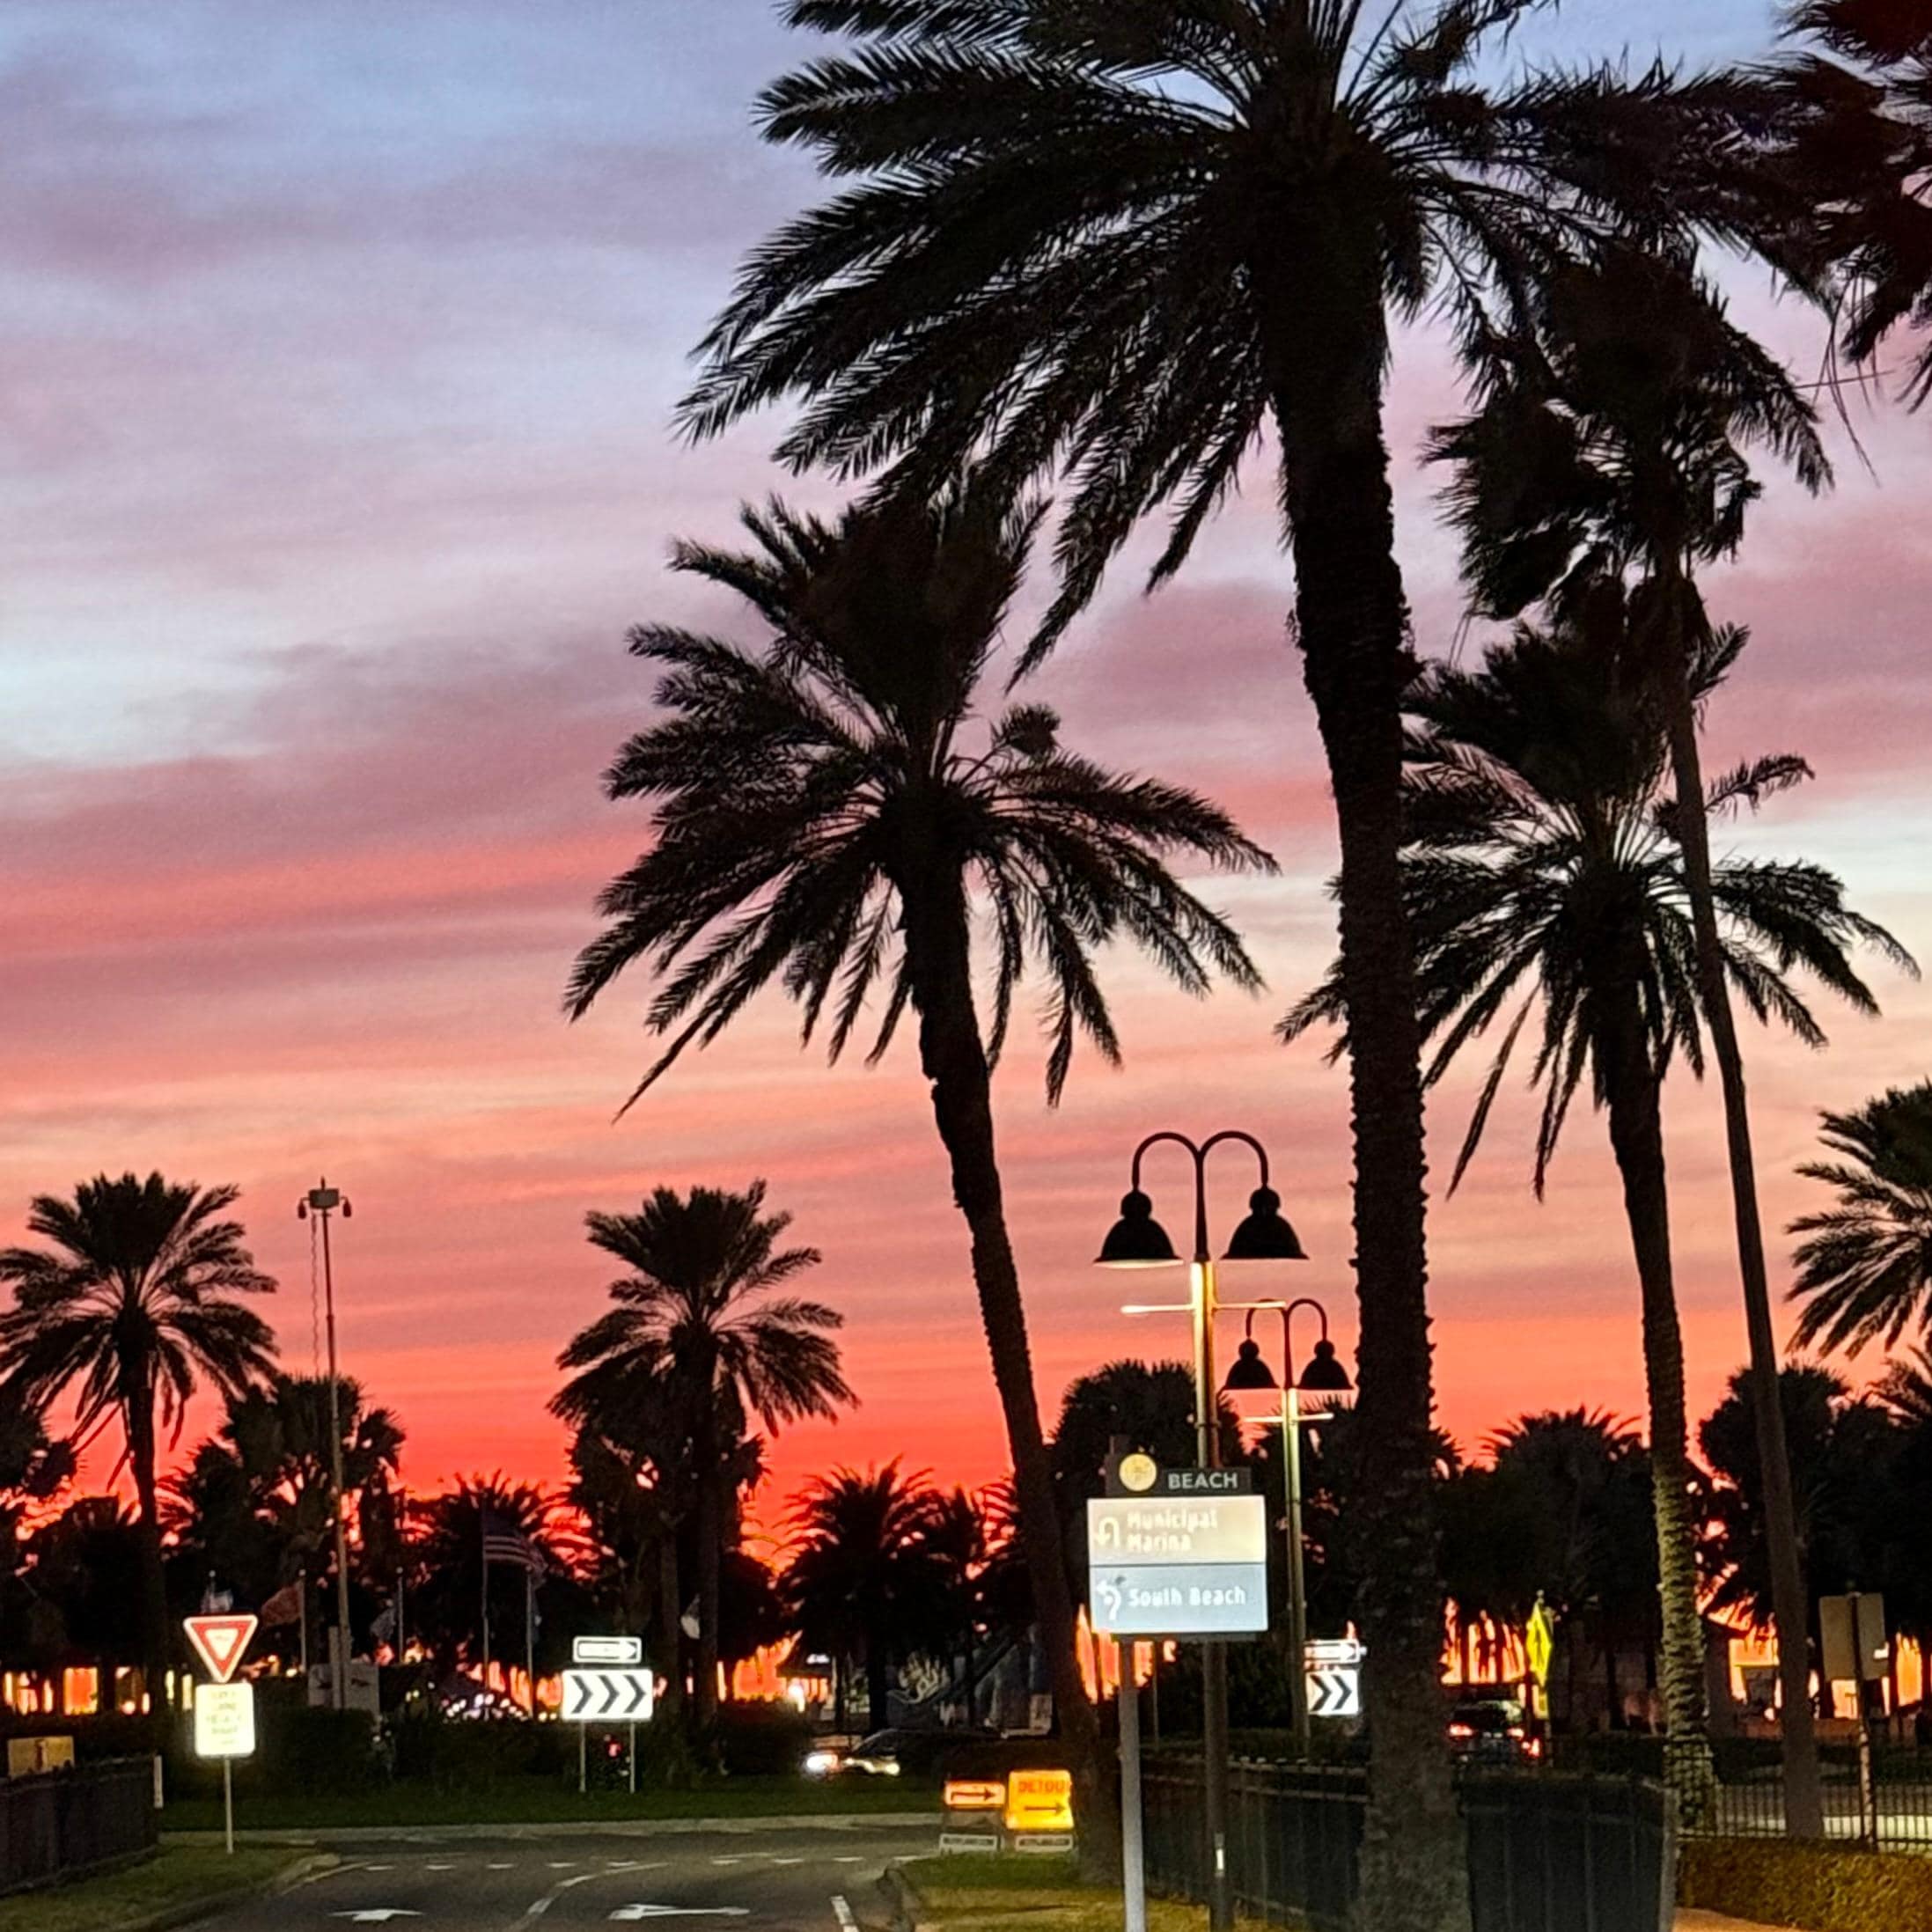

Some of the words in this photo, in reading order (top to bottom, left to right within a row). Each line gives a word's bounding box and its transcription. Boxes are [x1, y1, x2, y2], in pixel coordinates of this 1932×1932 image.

[1168, 1473, 1238, 1489] BEACH
[1127, 1508, 1218, 1533] Municipal
[1127, 1533, 1192, 1553] Marina
[1128, 1587, 1183, 1607] South
[1189, 1586, 1246, 1606] Beach
[1018, 1780, 1071, 1794] DETOU
